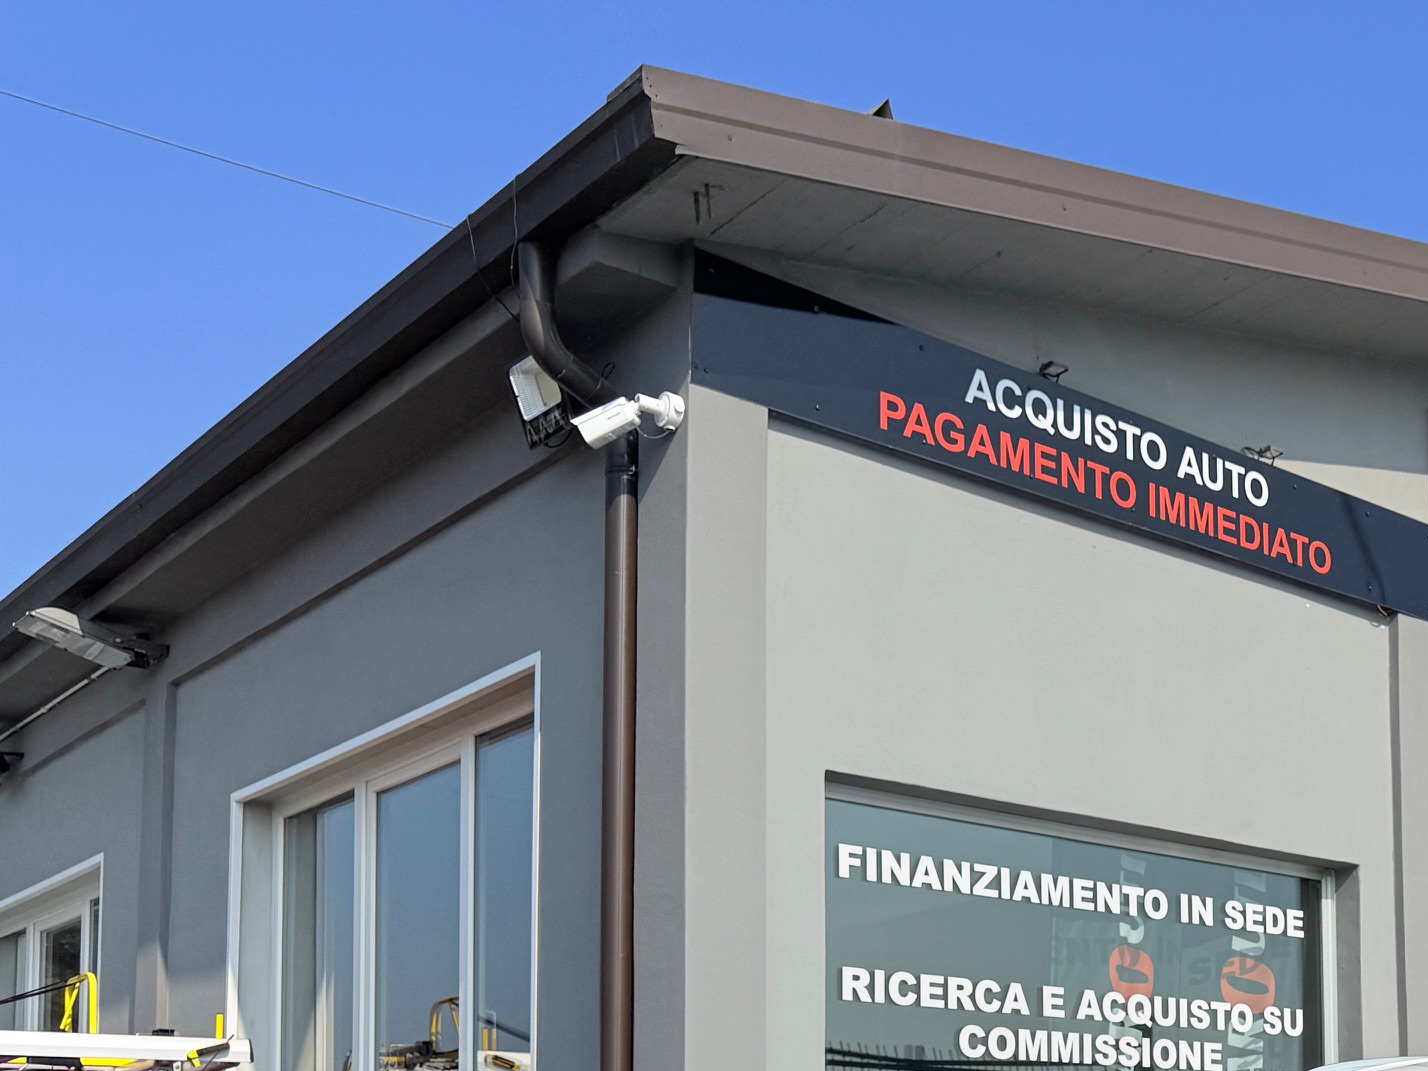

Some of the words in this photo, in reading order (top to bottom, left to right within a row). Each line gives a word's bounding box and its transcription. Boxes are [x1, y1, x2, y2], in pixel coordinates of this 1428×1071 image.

[879, 391, 1137, 508] PAGAMENTO
[1148, 482, 1332, 575] IMMEDIATO
[964, 368, 1167, 471] ACQUISTO
[1177, 446, 1269, 507] AUTO
[837, 843, 1168, 920] FINANZIAMENTO
[1180, 893, 1213, 927] IN
[1224, 900, 1305, 939] SEDE
[841, 965, 1030, 1016] RICERCA
[1043, 985, 1066, 1019] E
[1076, 989, 1254, 1033] ACQUISTO
[1263, 1004, 1304, 1038] SU
